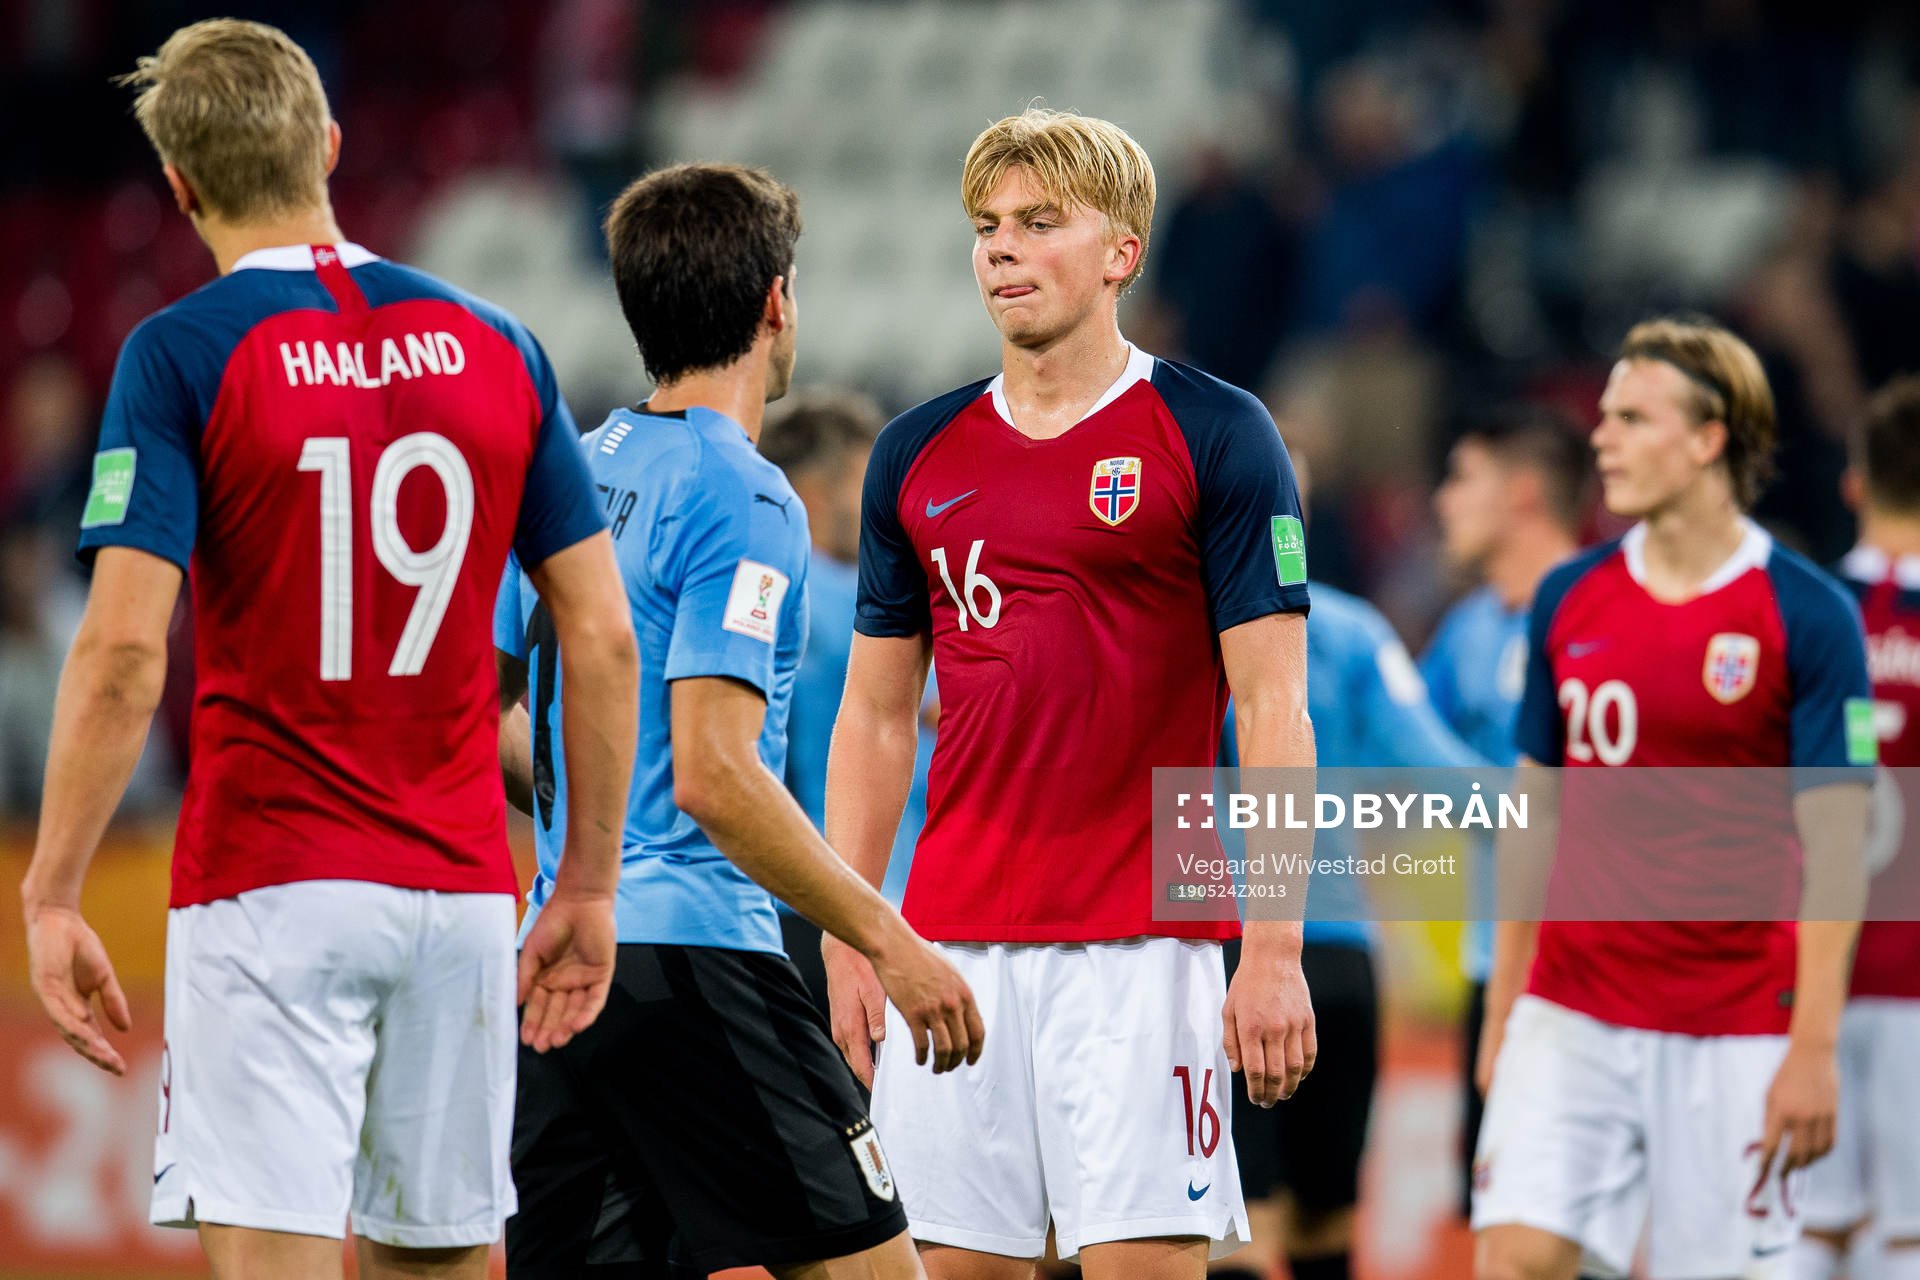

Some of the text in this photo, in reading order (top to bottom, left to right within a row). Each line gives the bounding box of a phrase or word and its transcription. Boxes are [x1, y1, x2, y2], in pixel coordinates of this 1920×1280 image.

[279, 331, 466, 388] HAALAND
[296, 431, 475, 681] 19
[596, 483, 637, 540] VA
[930, 539, 1002, 632] 16
[1558, 677, 1638, 766] 20
[1172, 1065, 1221, 1159] 16
